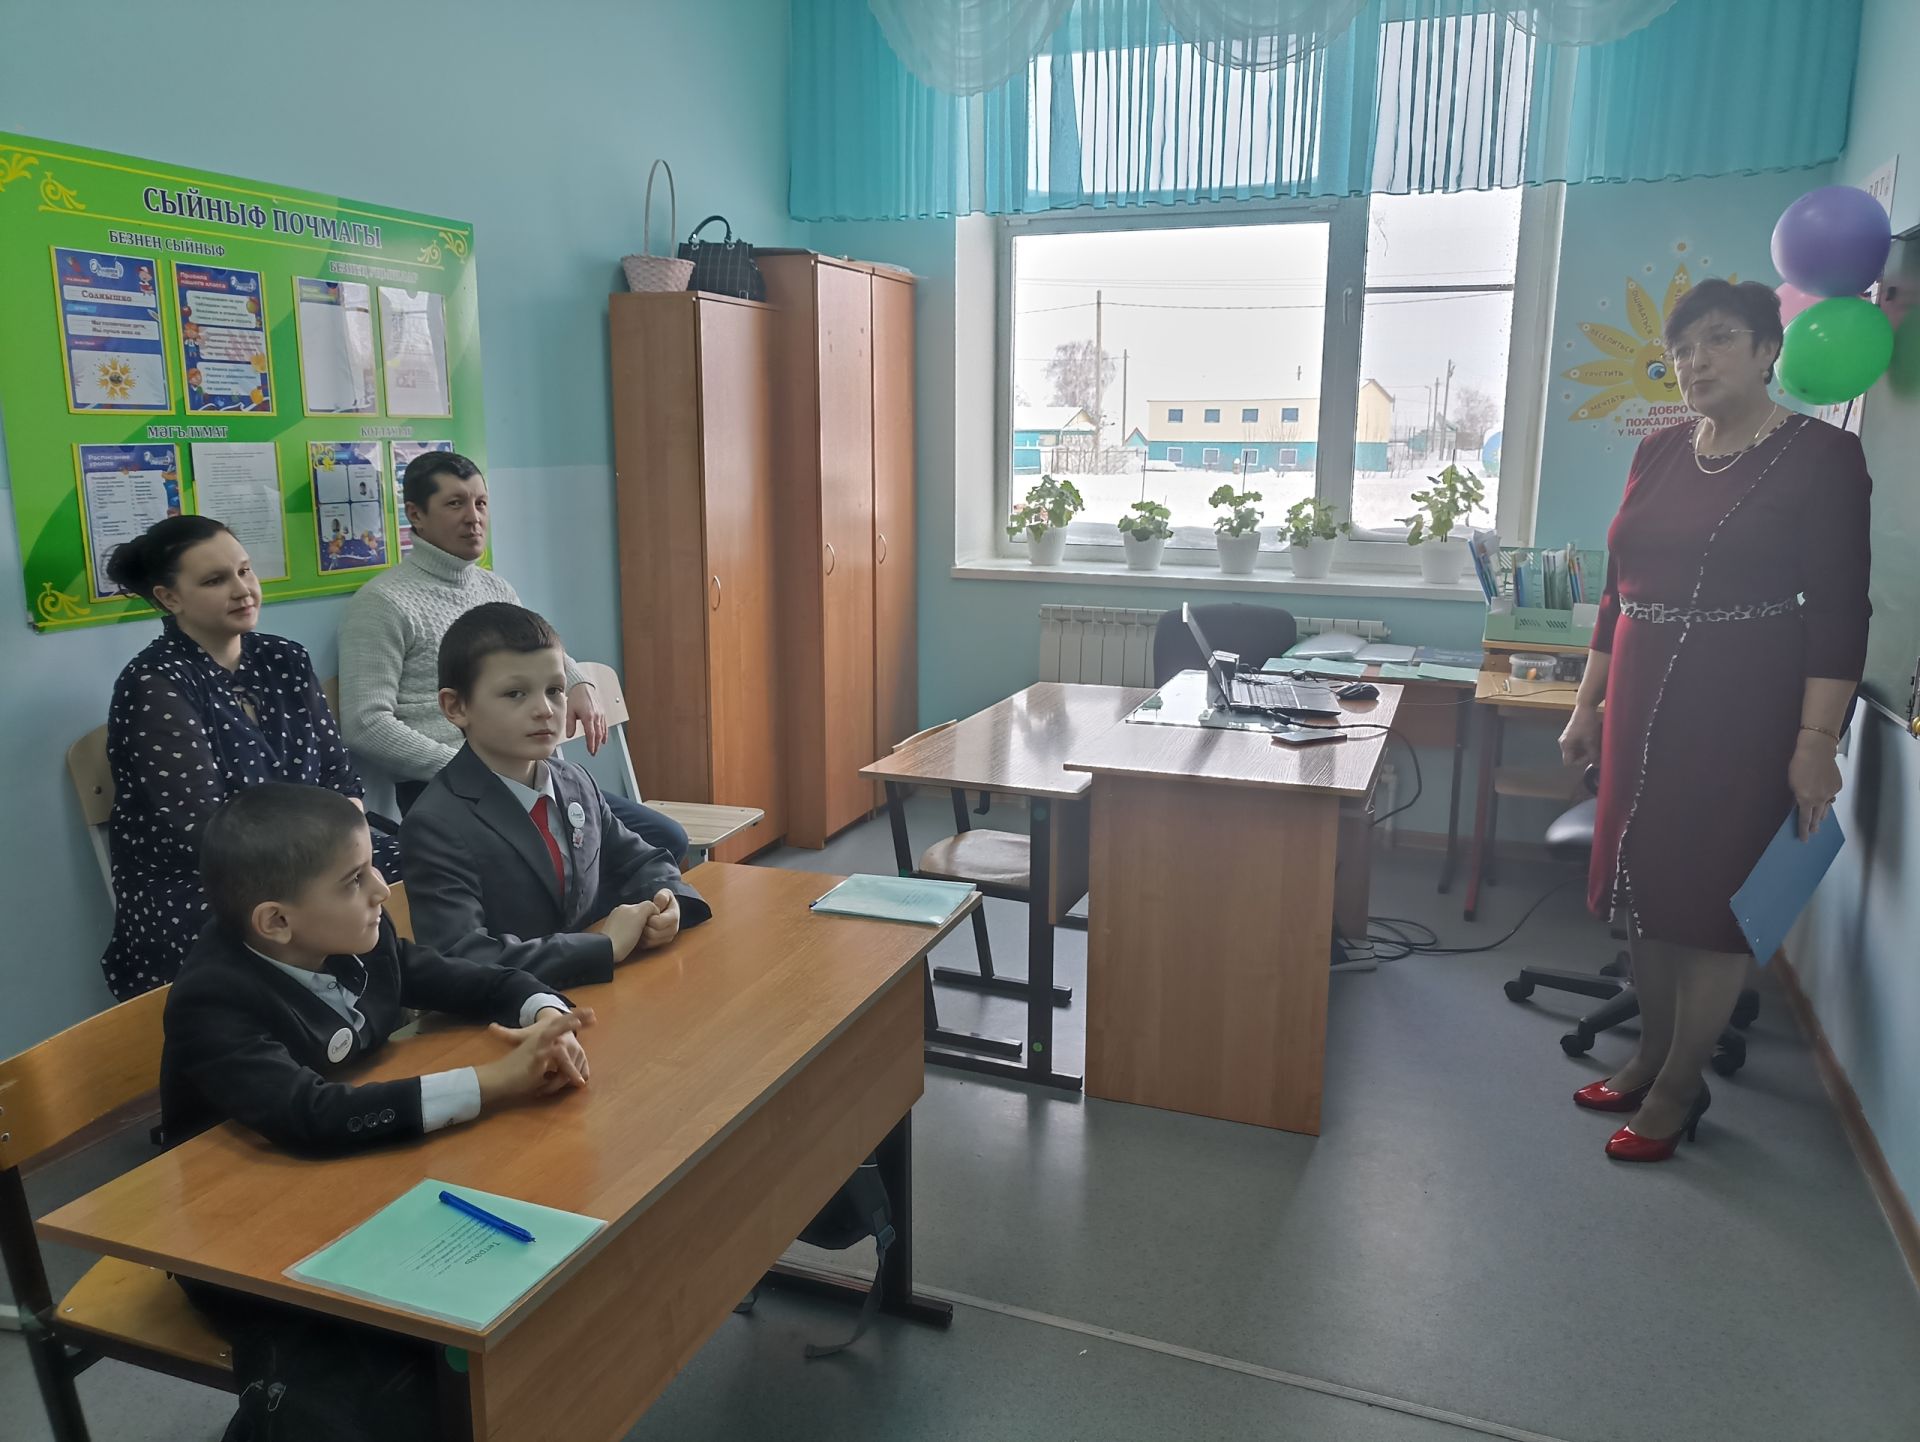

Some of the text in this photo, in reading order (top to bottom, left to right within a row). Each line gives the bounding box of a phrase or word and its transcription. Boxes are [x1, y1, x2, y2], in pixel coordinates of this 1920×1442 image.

[143, 187, 382, 249] СЫЙНЫФ ПОЧМАГЫ
[109, 230, 225, 257] БЕЗНЕҢ СЫЙНЫФ
[81, 290, 132, 302] Солнышко
[1590, 328, 1635, 354] ВЕСЕЛИТЬСЯ
[1590, 394, 1626, 411] МЕЧТАТЬ
[1648, 404, 1688, 417] ДОБРО
[1628, 428, 1647, 436] НАС
